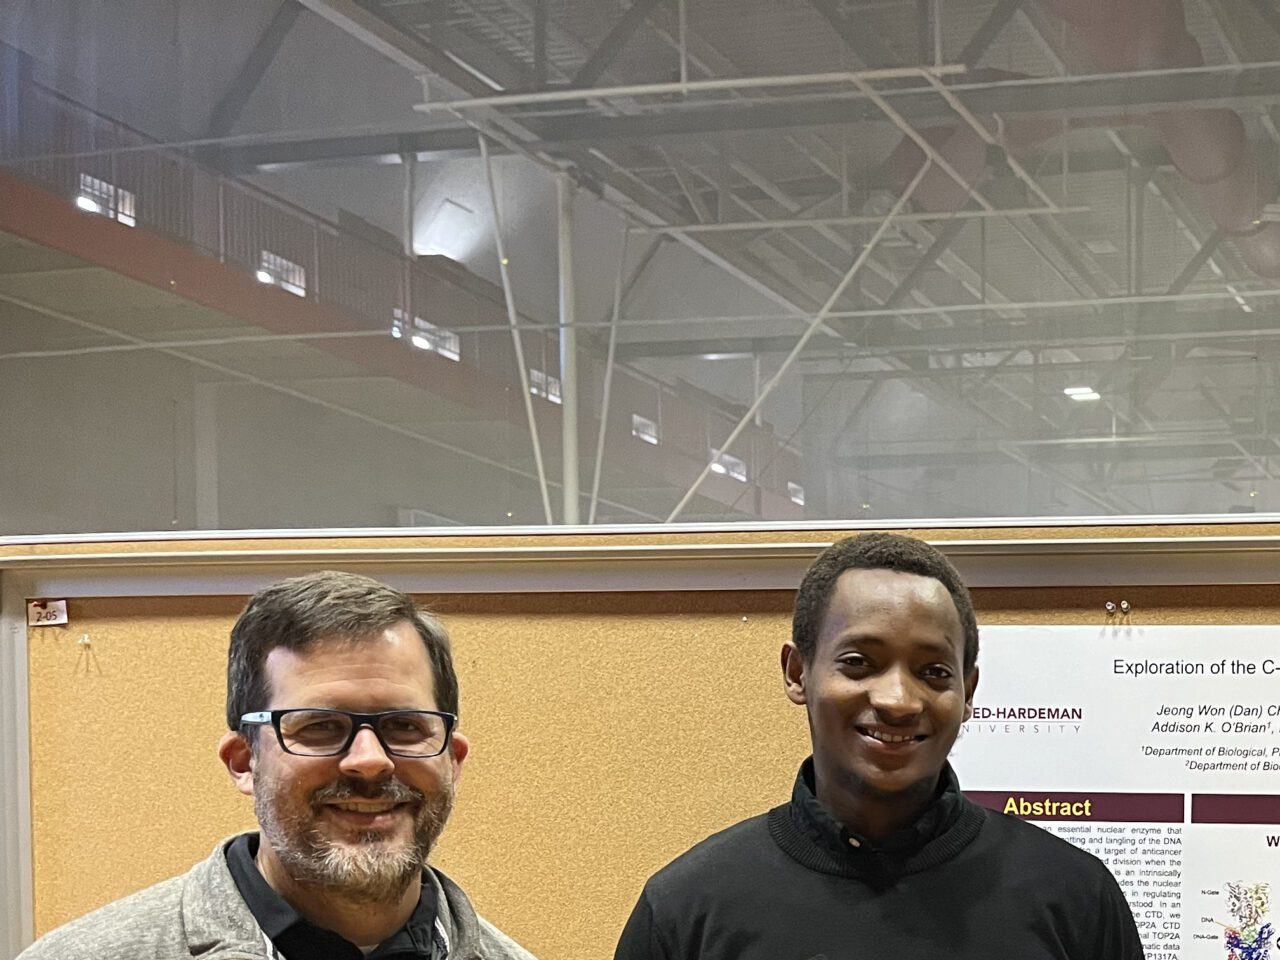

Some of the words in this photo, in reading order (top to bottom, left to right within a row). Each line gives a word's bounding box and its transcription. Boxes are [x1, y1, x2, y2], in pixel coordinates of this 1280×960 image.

[36, 610, 58, 622] 2-05
[1113, 659, 1204, 677] Exploration
[1210, 659, 1226, 674] of
[1230, 659, 1256, 674] the
[972, 707, 1083, 720] ED-HARDEMAN
[1156, 704, 1194, 718] Jeong
[1198, 704, 1225, 716] Won
[1229, 704, 1263, 719] (Dan)
[962, 724, 1081, 734] NIVERSITY
[1150, 721, 1200, 733] Addison
[1204, 746, 1216, 756] of
[1217, 746, 1267, 758] Biological,
[1249, 760, 1261, 770] of
[1003, 797, 1091, 816] Abstract
[1057, 825, 1091, 833] essential
[1130, 827, 1161, 835] enzyme
